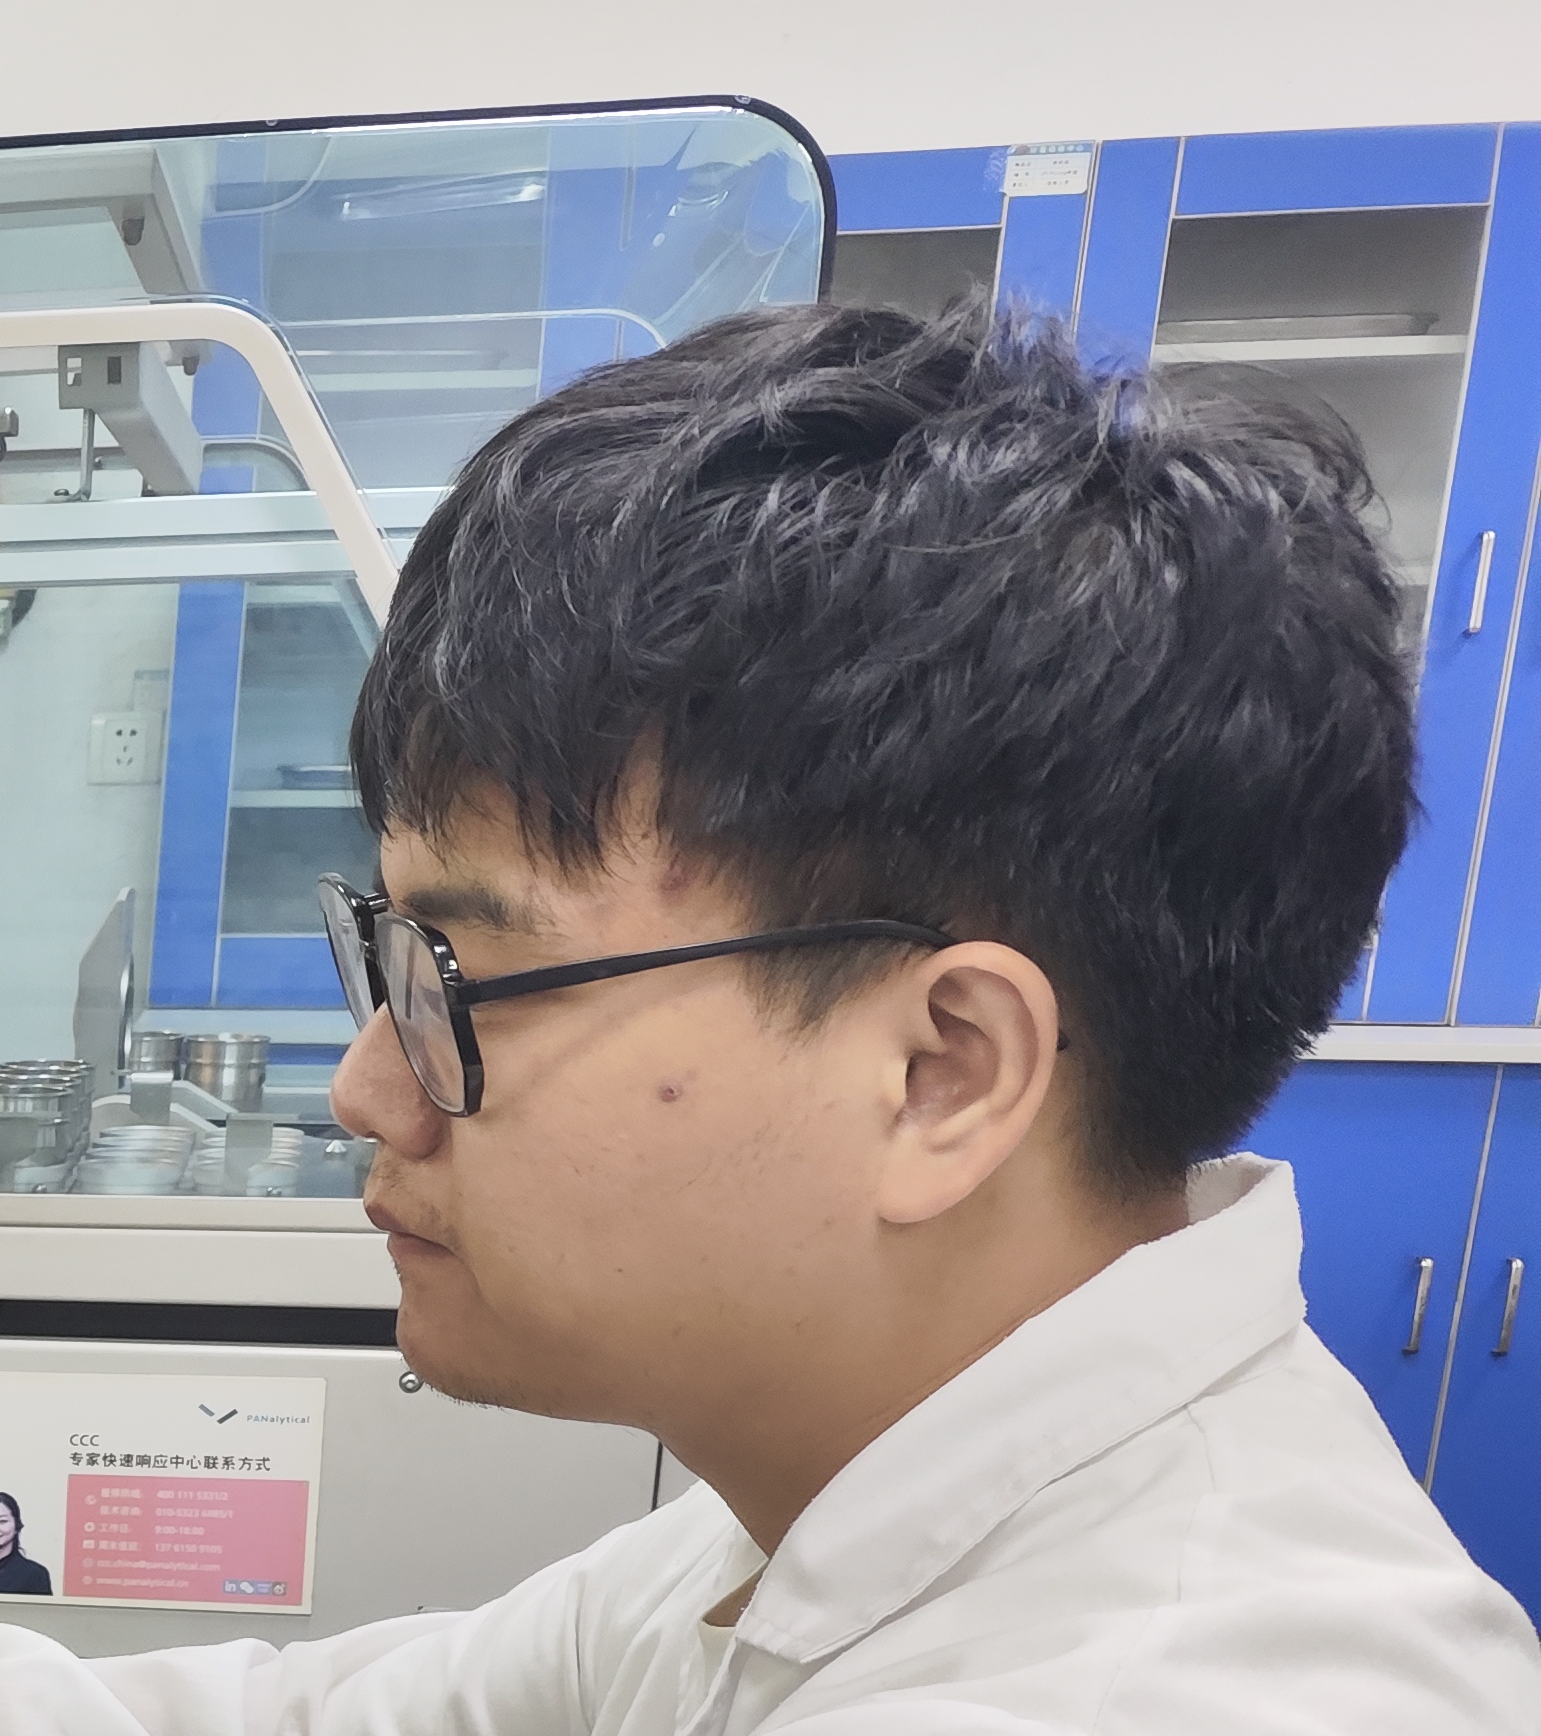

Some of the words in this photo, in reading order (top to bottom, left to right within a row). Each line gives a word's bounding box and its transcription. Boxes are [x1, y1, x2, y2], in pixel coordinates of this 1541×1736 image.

[246, 1414, 311, 1425] PANalytical
[69, 1433, 100, 1447] CCC
[69, 1452, 271, 1472] 专家快速响应中心联系方式
